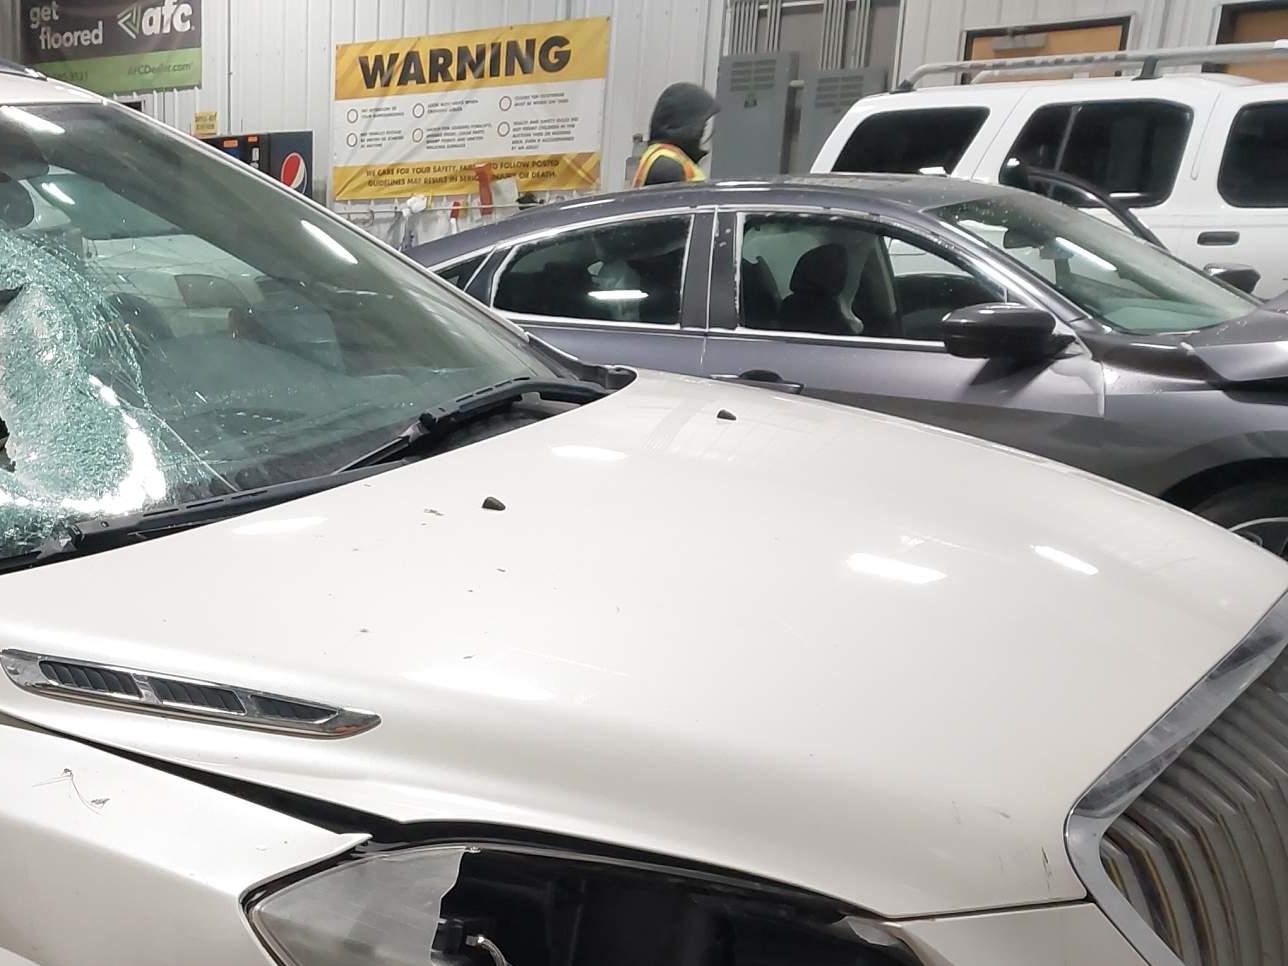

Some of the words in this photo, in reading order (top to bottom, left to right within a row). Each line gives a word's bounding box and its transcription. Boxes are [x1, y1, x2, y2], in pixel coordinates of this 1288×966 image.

[30, 1, 59, 29] get
[142, 0, 193, 36] afc
[39, 20, 103, 49] floored
[359, 35, 571, 89] WARNING
[412, 166, 431, 174] YOUR
